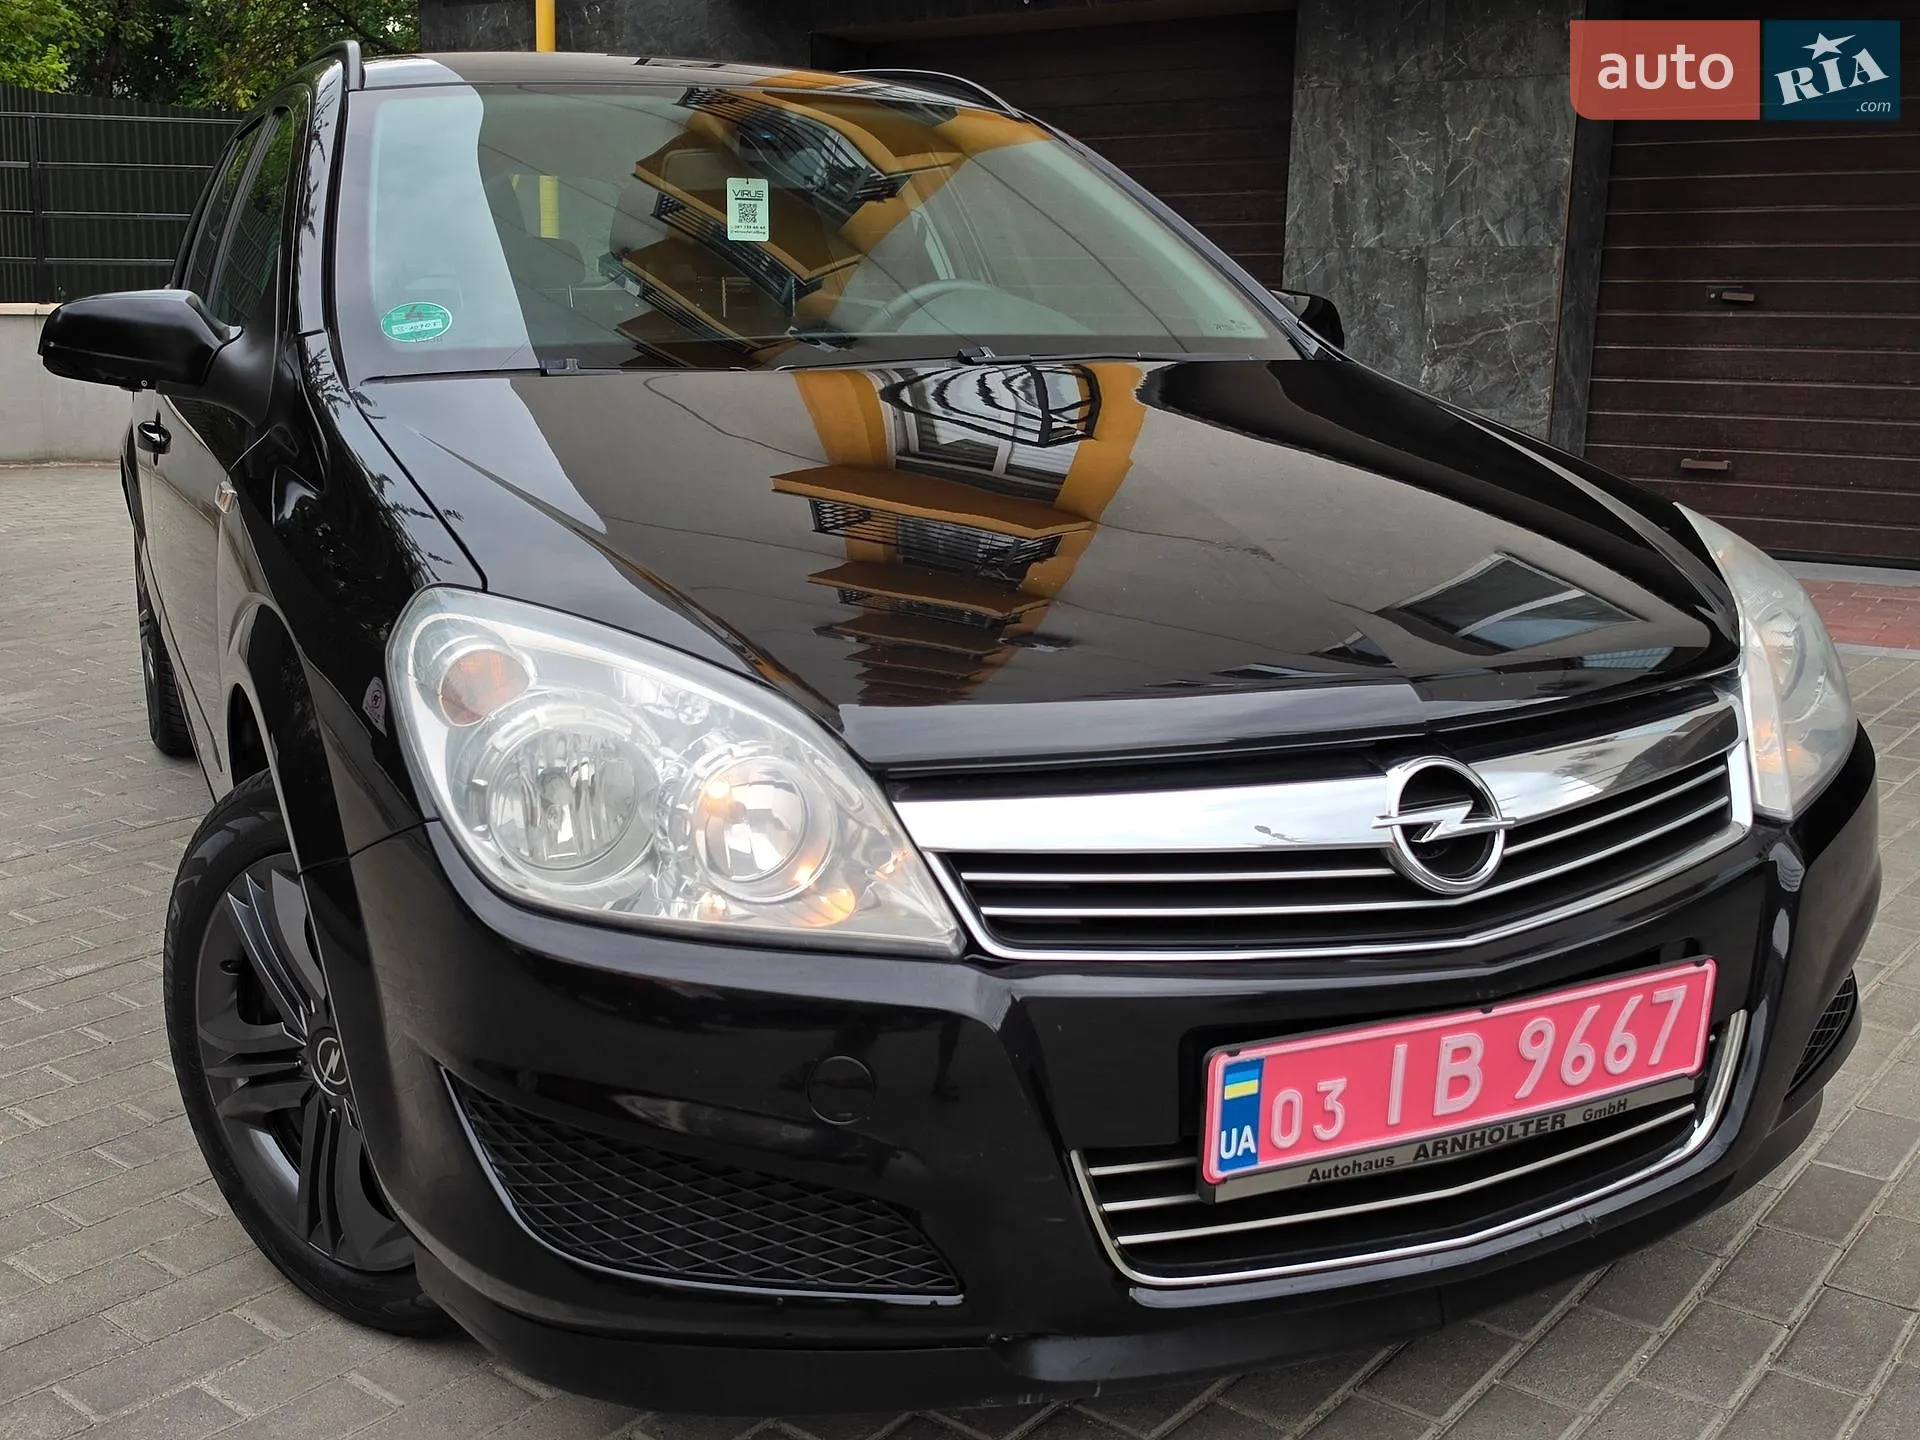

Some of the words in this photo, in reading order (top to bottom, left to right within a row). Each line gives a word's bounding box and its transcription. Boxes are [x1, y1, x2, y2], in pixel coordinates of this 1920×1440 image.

[732, 189, 764, 198] VIRUS
[1270, 1078, 1348, 1150] 03
[1514, 984, 1688, 1101] 9667
[1220, 1124, 1256, 1161] UA
[1307, 1153, 1395, 1184] Autohaus
[1412, 1112, 1566, 1163] ARNHOLTER
[1582, 1098, 1629, 1122] GmbH
